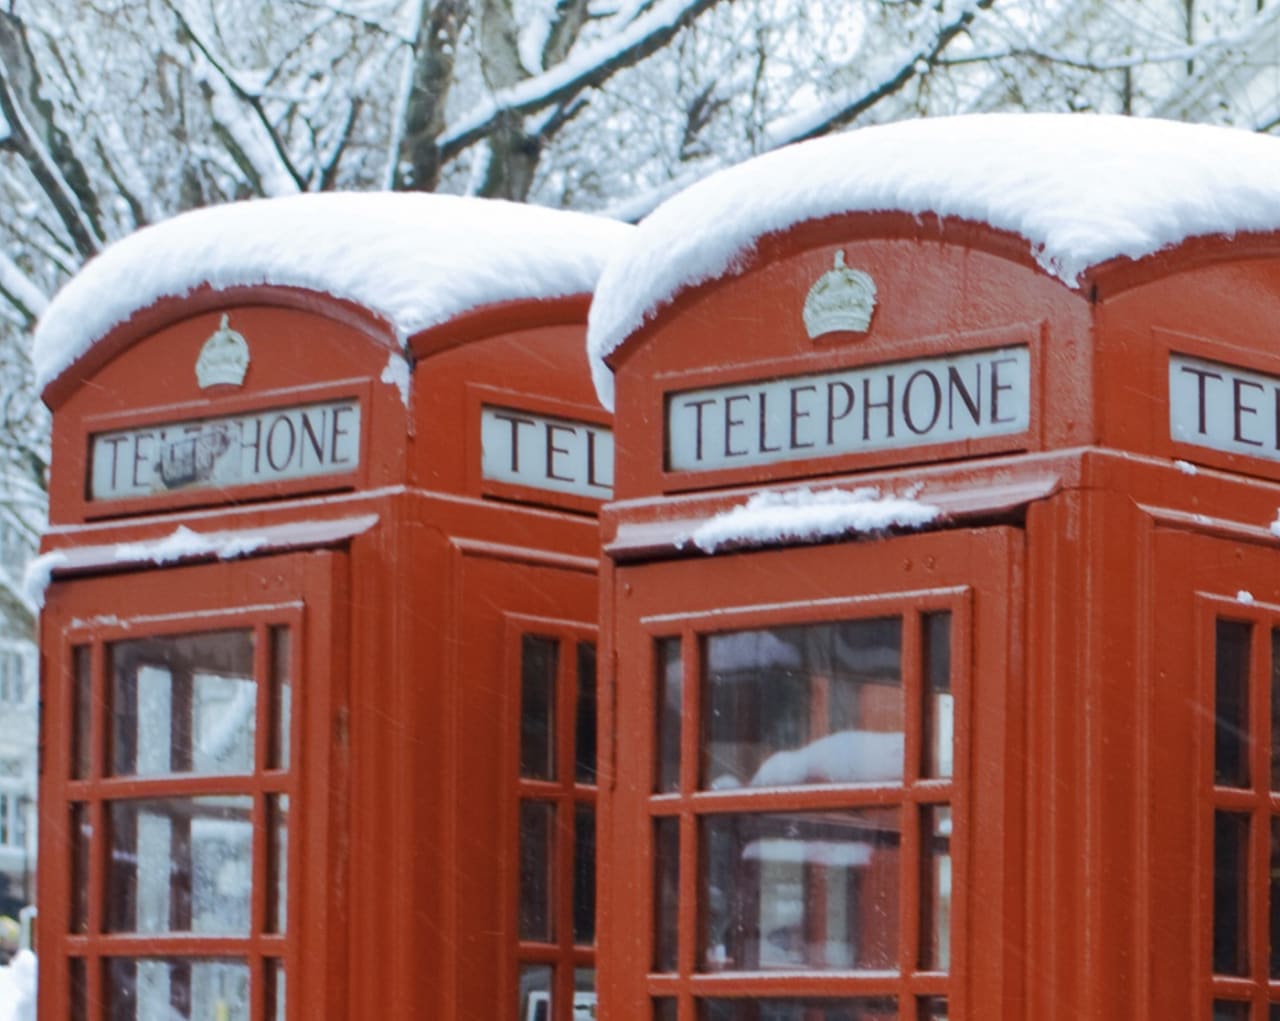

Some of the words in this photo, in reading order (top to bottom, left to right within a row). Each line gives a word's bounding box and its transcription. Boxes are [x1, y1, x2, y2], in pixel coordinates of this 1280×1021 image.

[104, 406, 353, 490] TEHONE
[493, 412, 615, 489] TEL
[683, 358, 1018, 461] TELEPHONE
